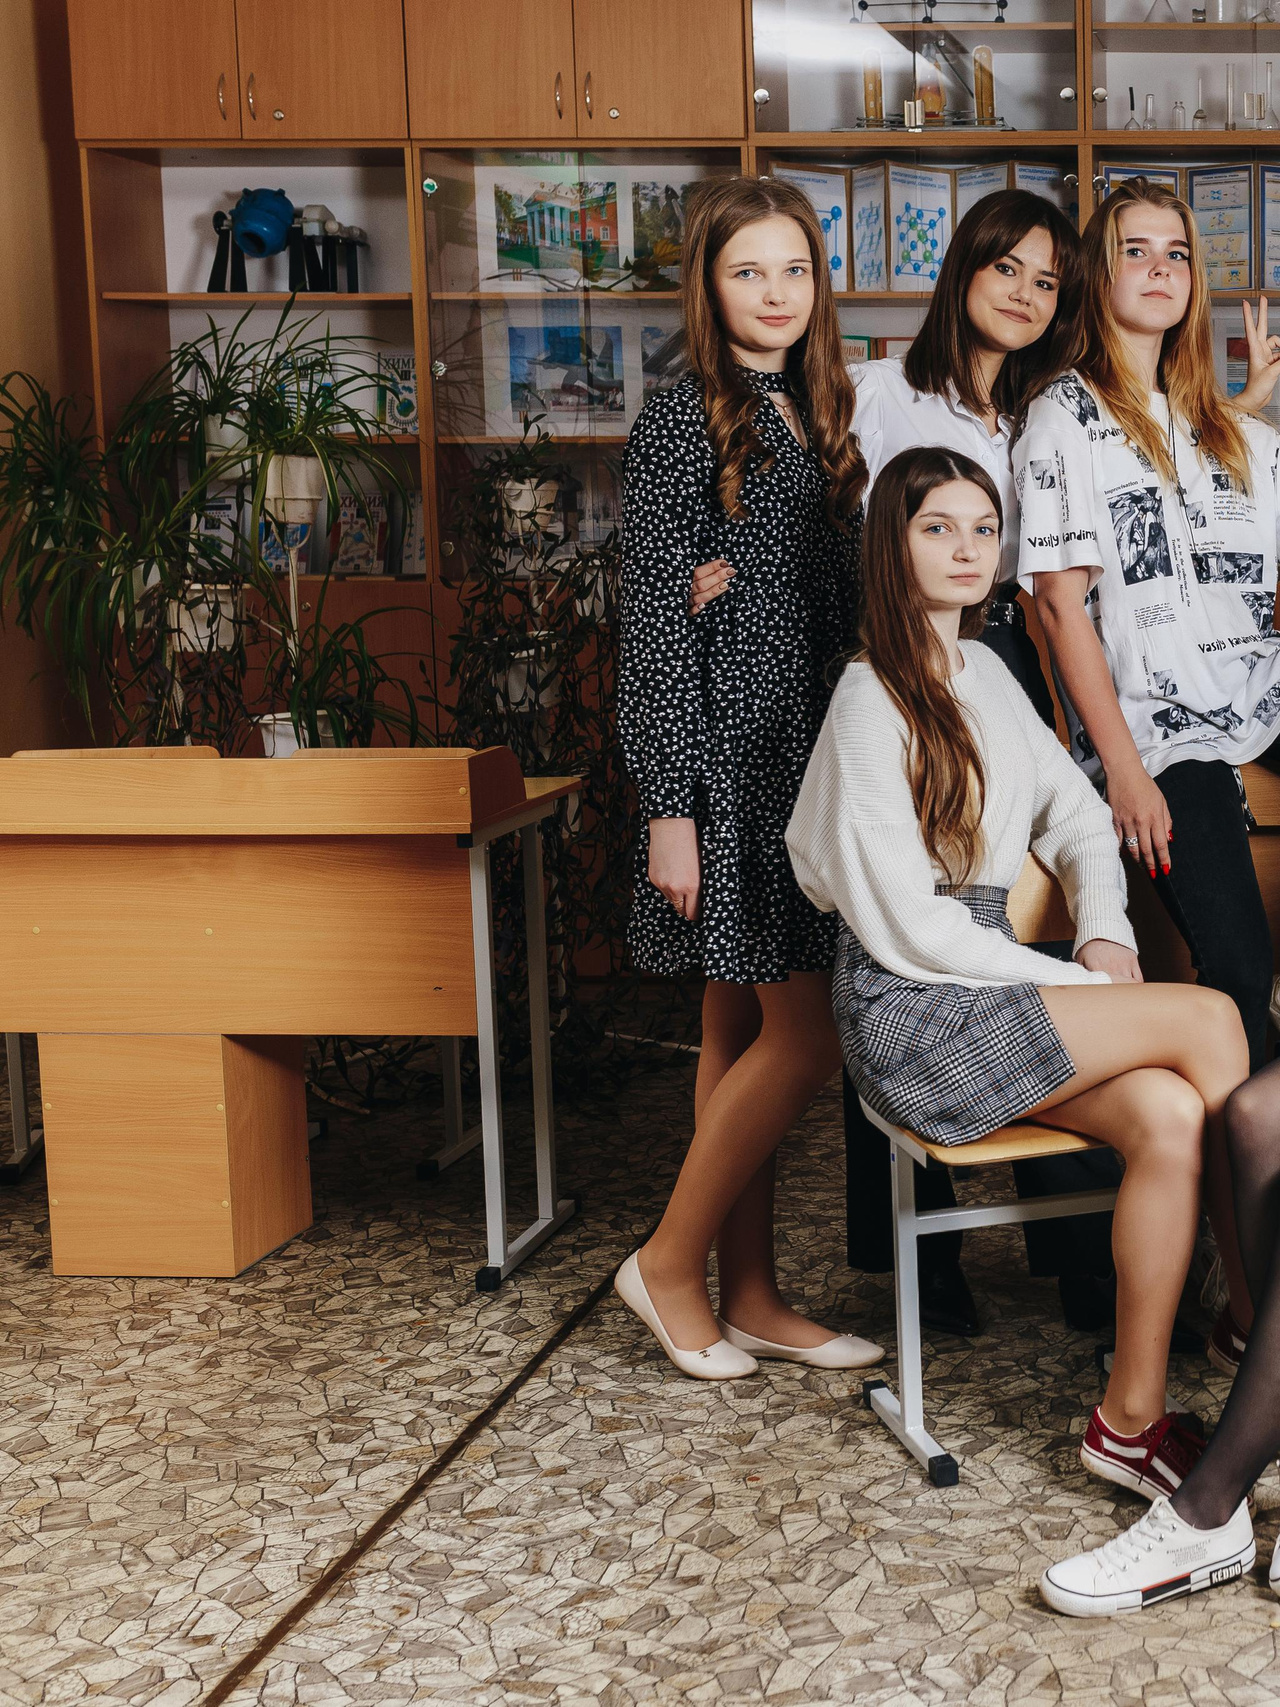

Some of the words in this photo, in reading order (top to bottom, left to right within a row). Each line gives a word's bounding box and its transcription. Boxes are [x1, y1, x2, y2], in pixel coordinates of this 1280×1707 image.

[1104, 480, 1139, 495] Improvisation
[340, 496, 384, 508] ХИИЯ
[1027, 533, 1060, 548] Vasily
